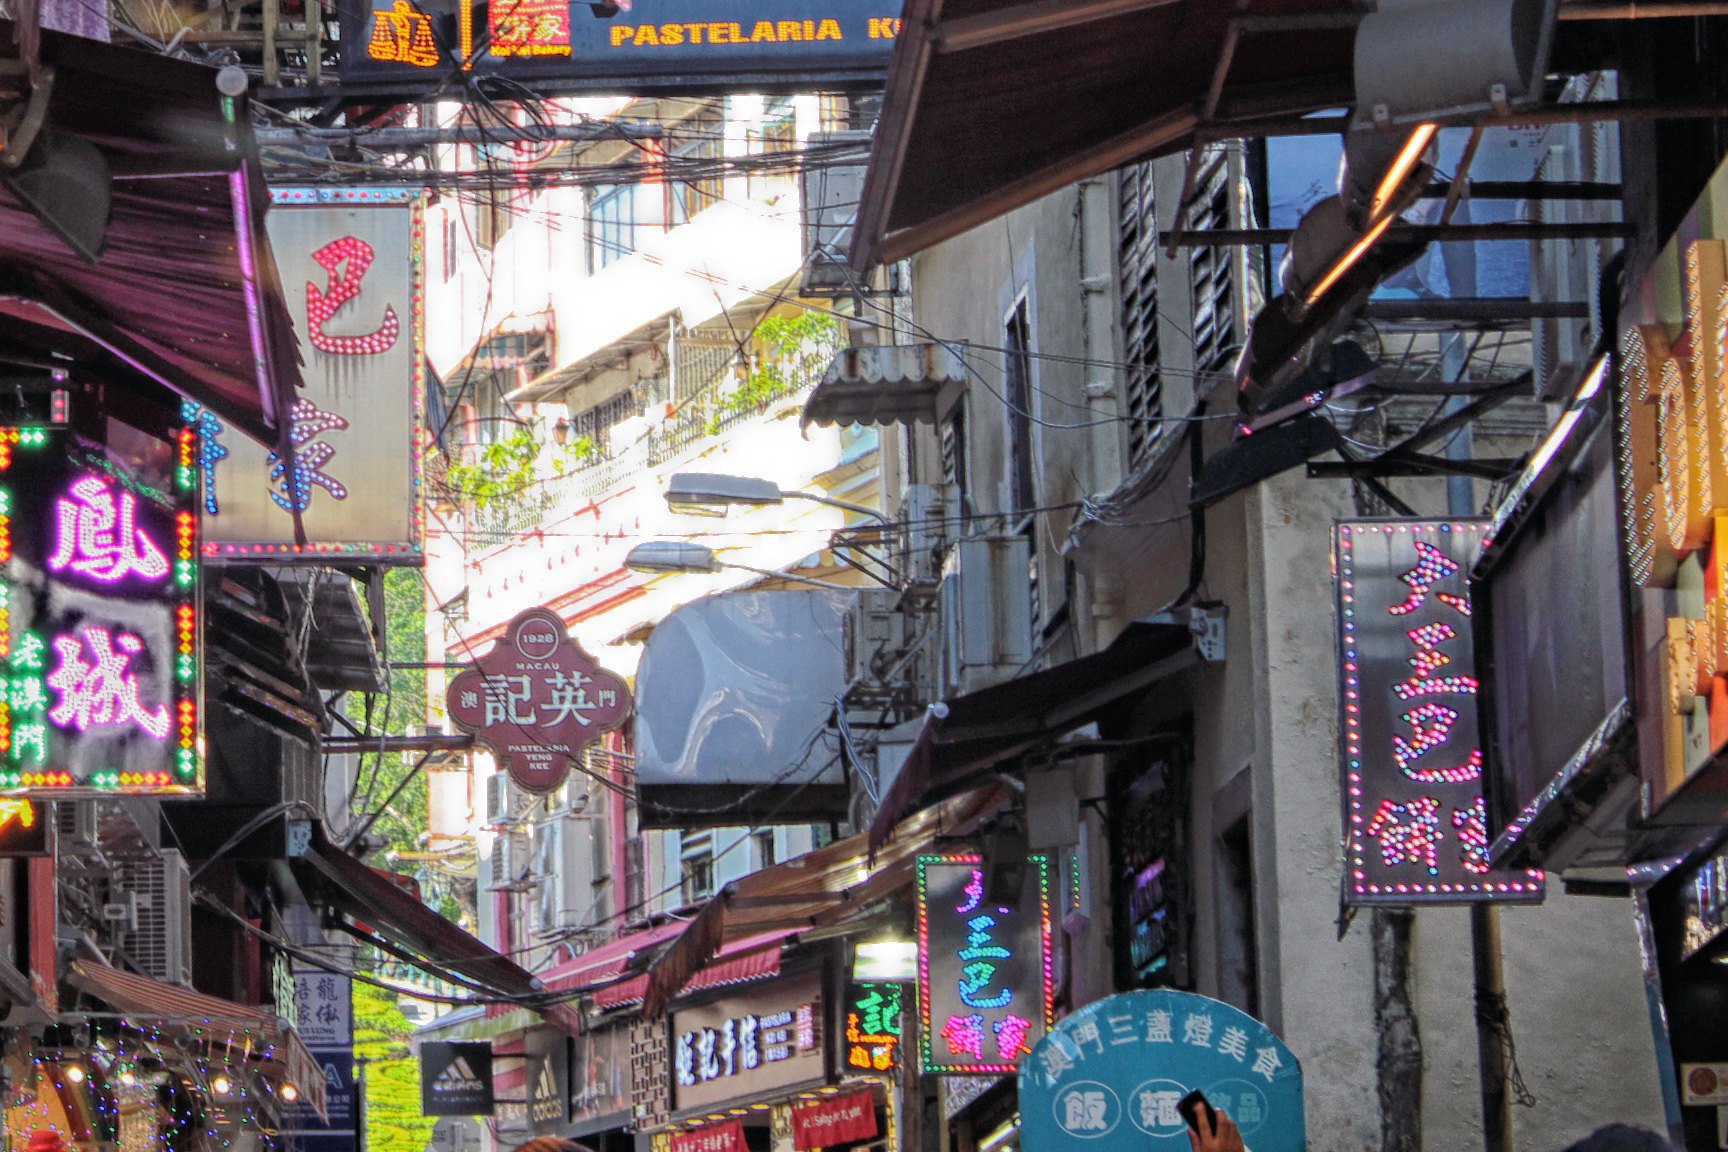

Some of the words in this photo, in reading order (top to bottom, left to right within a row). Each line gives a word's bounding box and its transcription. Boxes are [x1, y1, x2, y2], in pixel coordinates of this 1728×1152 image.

[610, 18, 843, 47] PASTELARIA
[48, 475, 171, 740] 鳳城
[522, 633, 555, 644] 1928
[515, 662, 560, 670] MACAU
[11, 630, 48, 762] 老澳門
[525, 753, 553, 762] YENG
[529, 762, 550, 771] KEE
[1063, 1091, 1108, 1131] 飯
